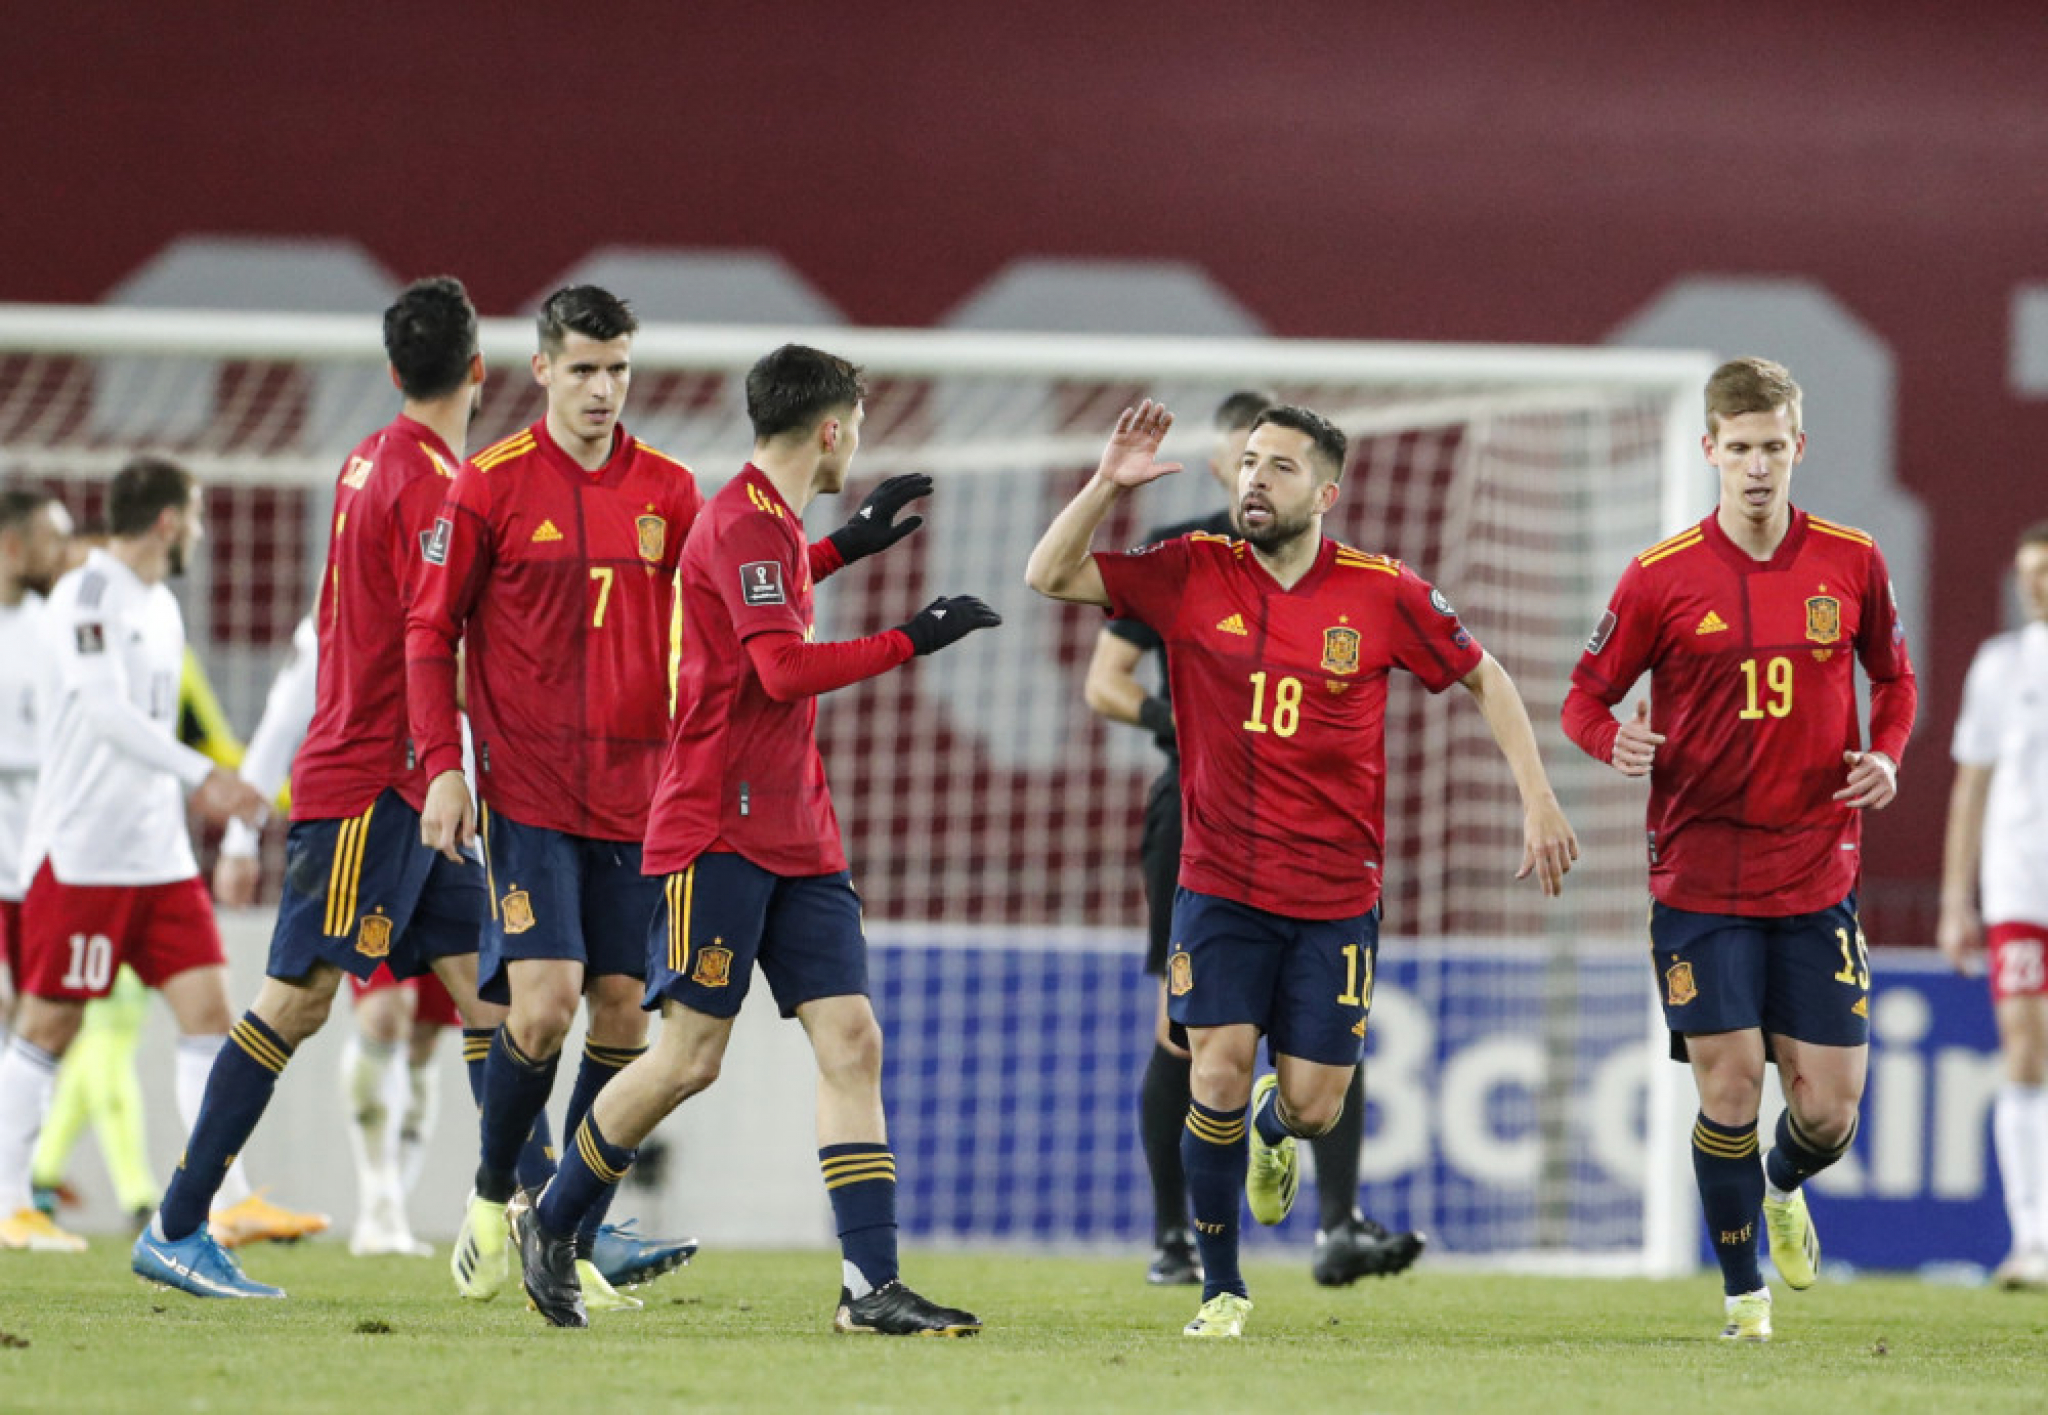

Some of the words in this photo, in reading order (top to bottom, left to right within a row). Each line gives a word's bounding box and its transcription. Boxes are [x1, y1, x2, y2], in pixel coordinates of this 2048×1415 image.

[590, 566, 613, 628] 7
[1243, 671, 1302, 737] 18
[1739, 655, 1793, 719] 19
[61, 932, 111, 990] 10
